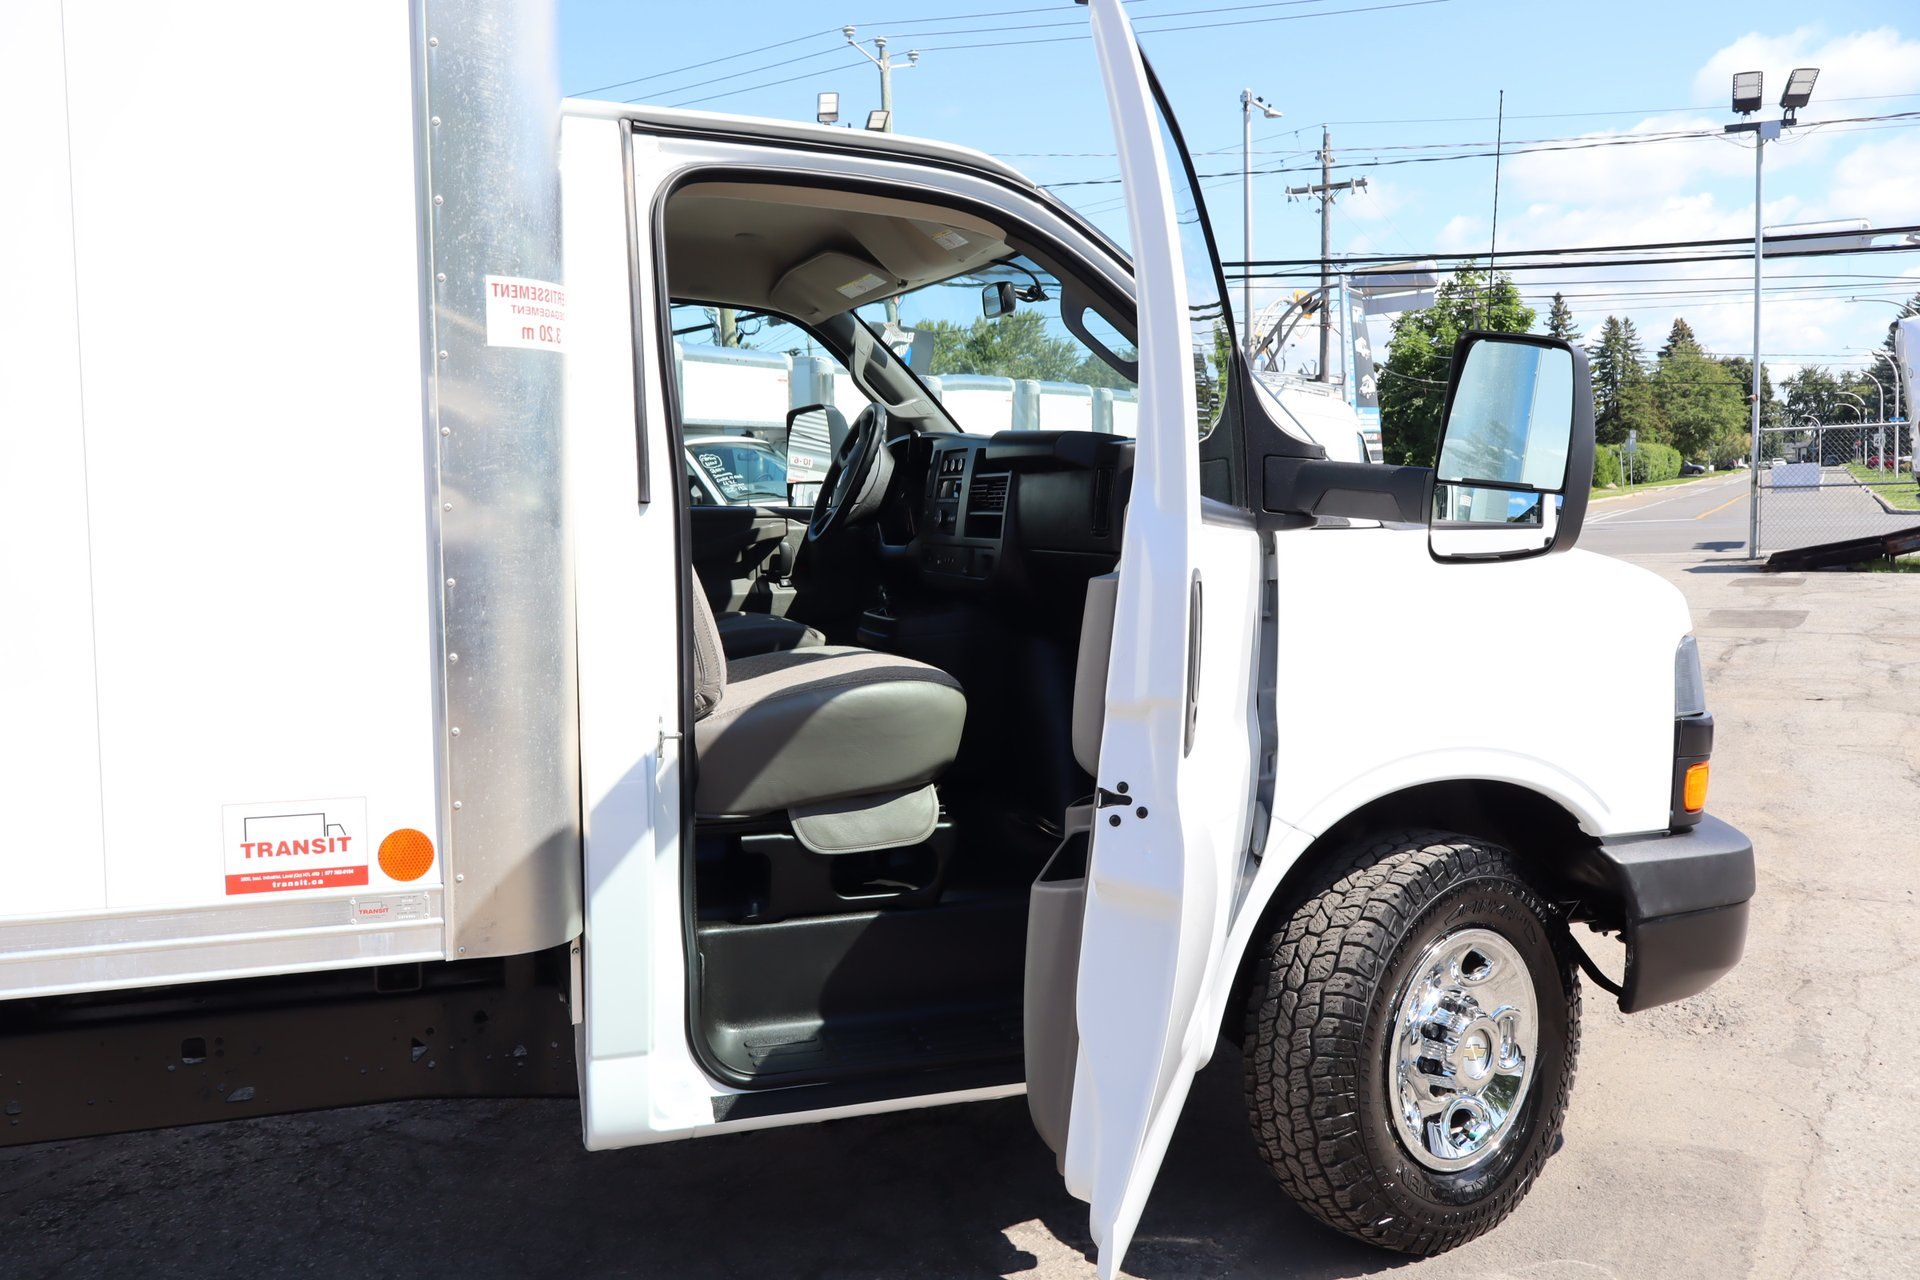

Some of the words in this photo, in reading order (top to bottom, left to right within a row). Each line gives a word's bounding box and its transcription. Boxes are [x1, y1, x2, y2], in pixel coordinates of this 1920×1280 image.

[239, 836, 352, 859] TRANSIT
[271, 878, 324, 889] transit.ca
[358, 907, 390, 915] TRANSIT
